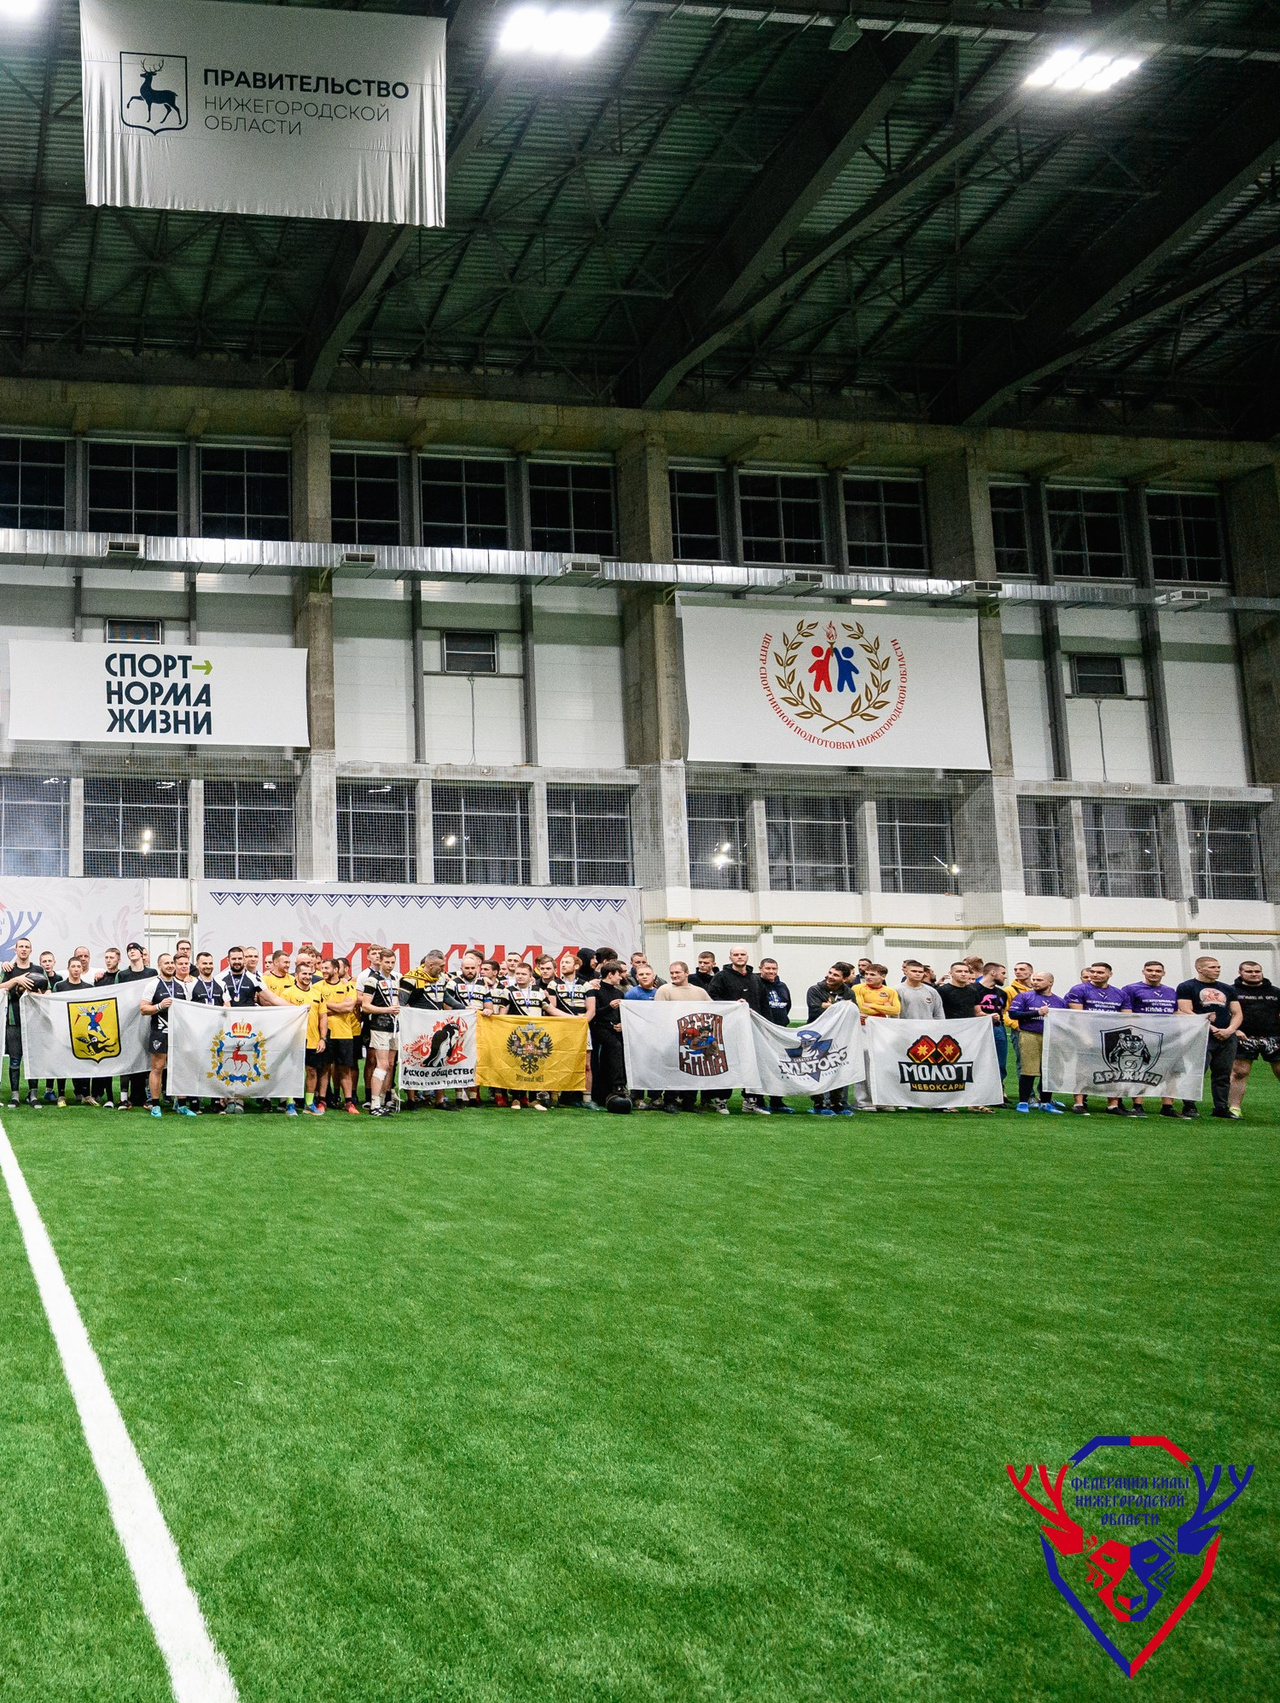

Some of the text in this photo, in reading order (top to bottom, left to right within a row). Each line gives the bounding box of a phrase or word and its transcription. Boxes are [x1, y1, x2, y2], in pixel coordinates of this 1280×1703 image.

[203, 68, 410, 99] ПРАВИТЕЛЬСТВО
[204, 96, 390, 122] НИЖЕГОРОДСКОЙ
[204, 115, 302, 136] ОБЛАСТИ
[105, 653, 192, 678] СПОРТ
[106, 681, 212, 707] НОРМА
[759, 632, 908, 750] ЦЕНТР СПОРТИВНОЙ ПОДГОТОВКИ НИЖЕГОРОДСКОЙ ОБЛАСТИ
[106, 709, 213, 735] ЖИЗНИ
[900, 1062, 973, 1081] МОЛОТ
[1094, 1070, 1162, 1086] ДРУЖИНА
[911, 1082, 965, 1091] ЧЕБОКСАРЫ
